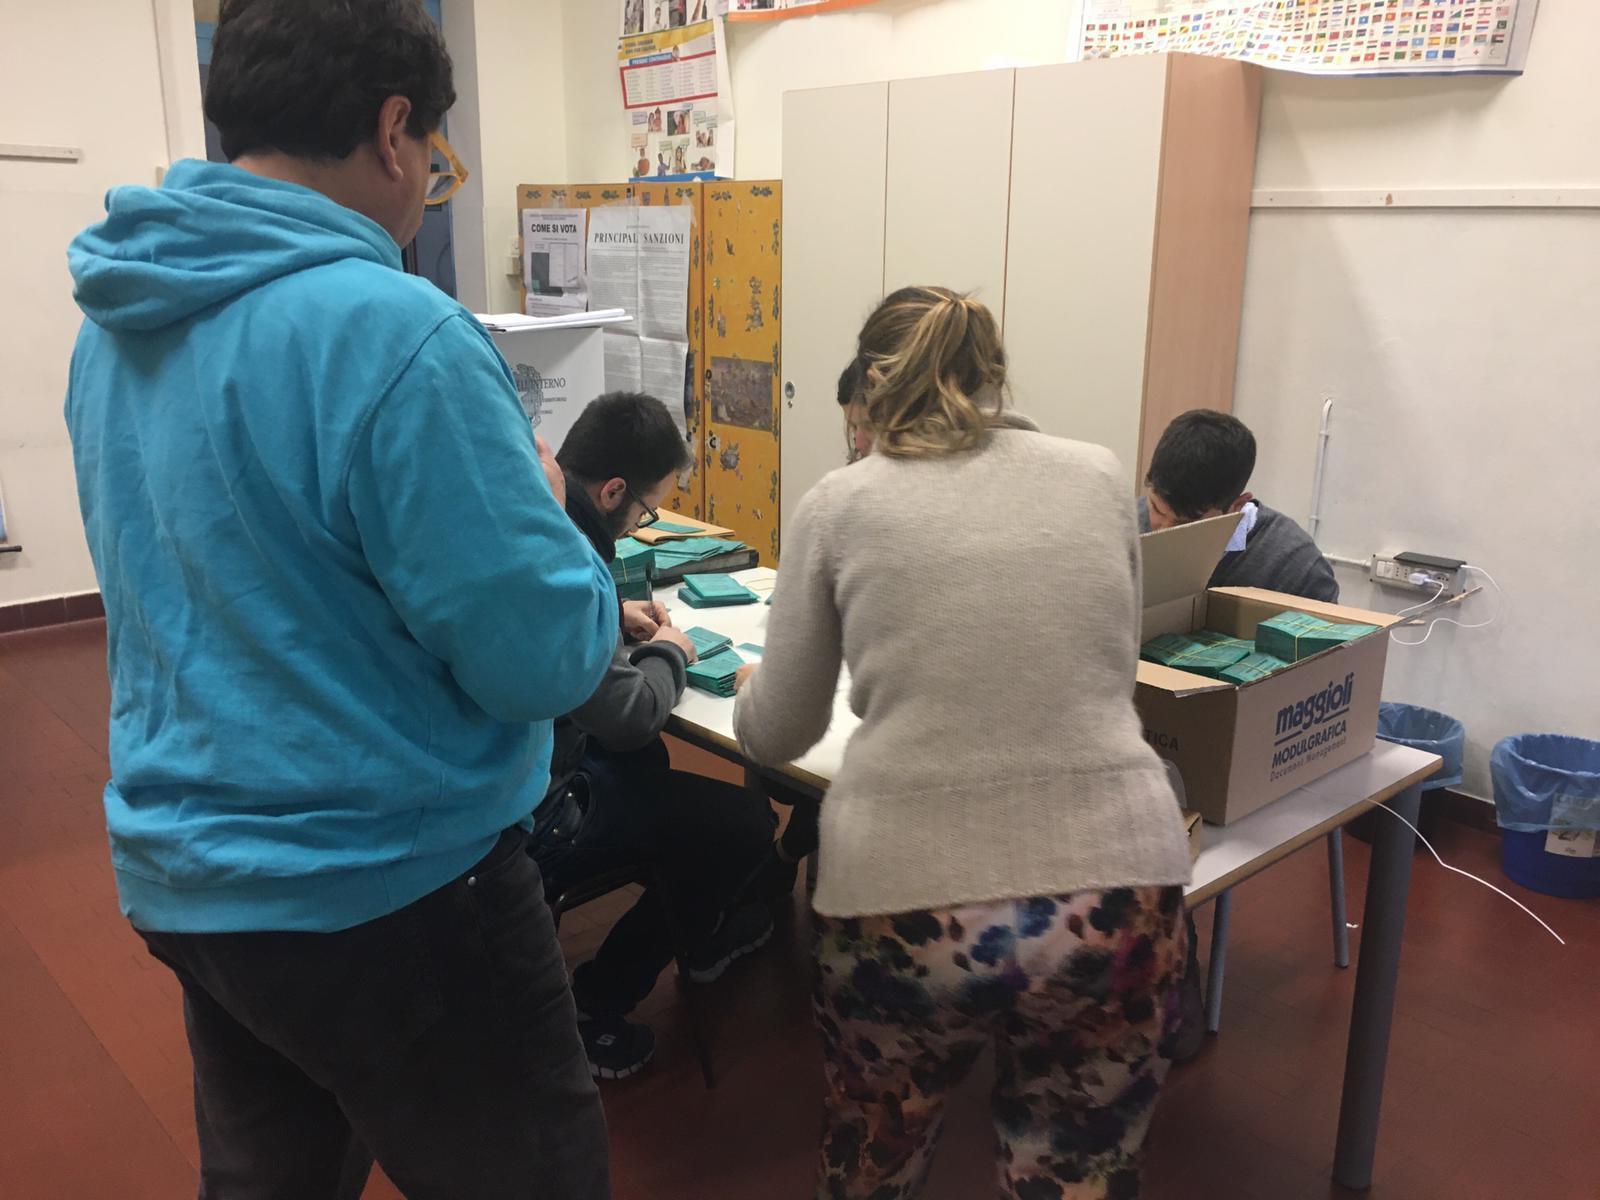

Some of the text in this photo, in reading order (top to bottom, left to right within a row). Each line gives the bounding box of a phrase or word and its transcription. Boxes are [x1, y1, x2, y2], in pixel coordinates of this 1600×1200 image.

[531, 224, 577, 234] COME SI VOTA
[594, 232, 684, 245] PRINCIPAL SANZIONI
[1275, 671, 1354, 736] maggioli
[1143, 728, 1179, 751] TICA
[1271, 719, 1347, 769] MODULGRAFICA
